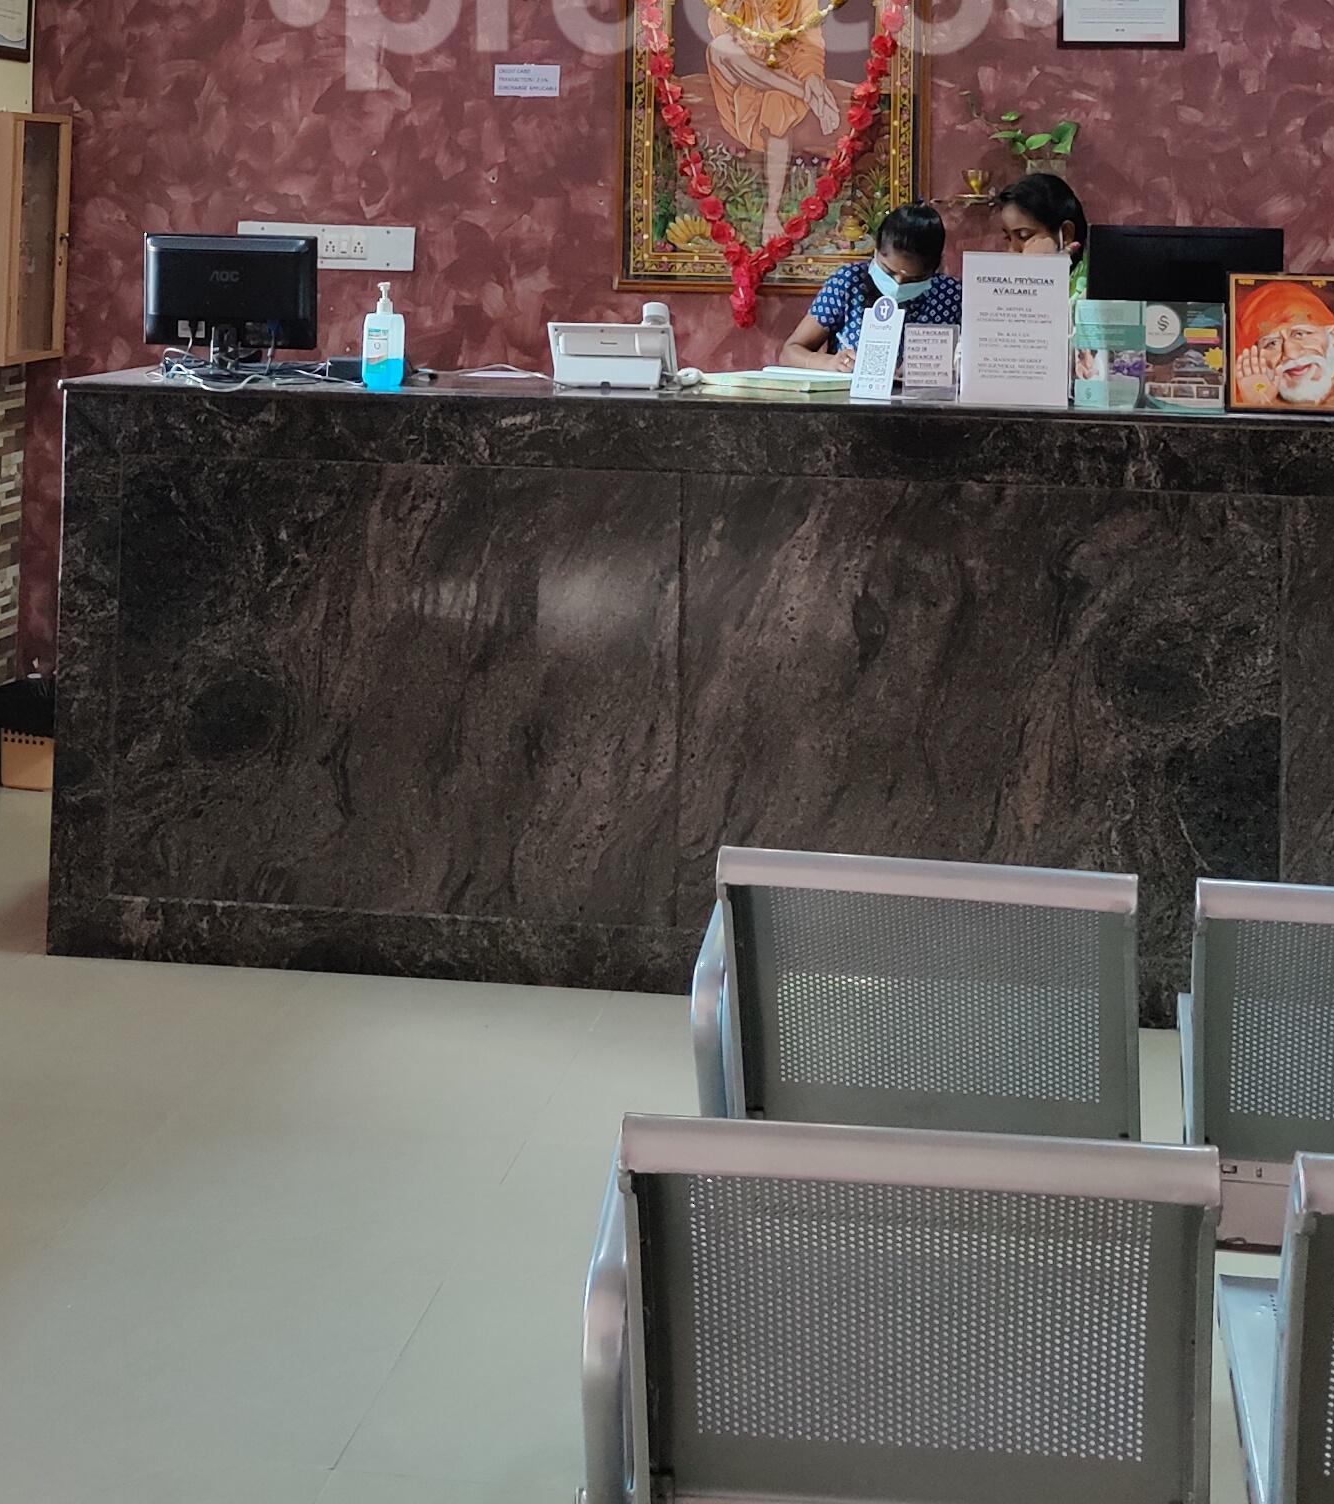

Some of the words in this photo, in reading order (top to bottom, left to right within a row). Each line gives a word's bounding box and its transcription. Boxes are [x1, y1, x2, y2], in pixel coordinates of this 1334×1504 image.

[209, 269, 241, 283] AOC
[976, 276, 1013, 285] GENERAL
[1014, 277, 1055, 286] PHYSICIAN
[992, 287, 1038, 296] AVAILABLE
